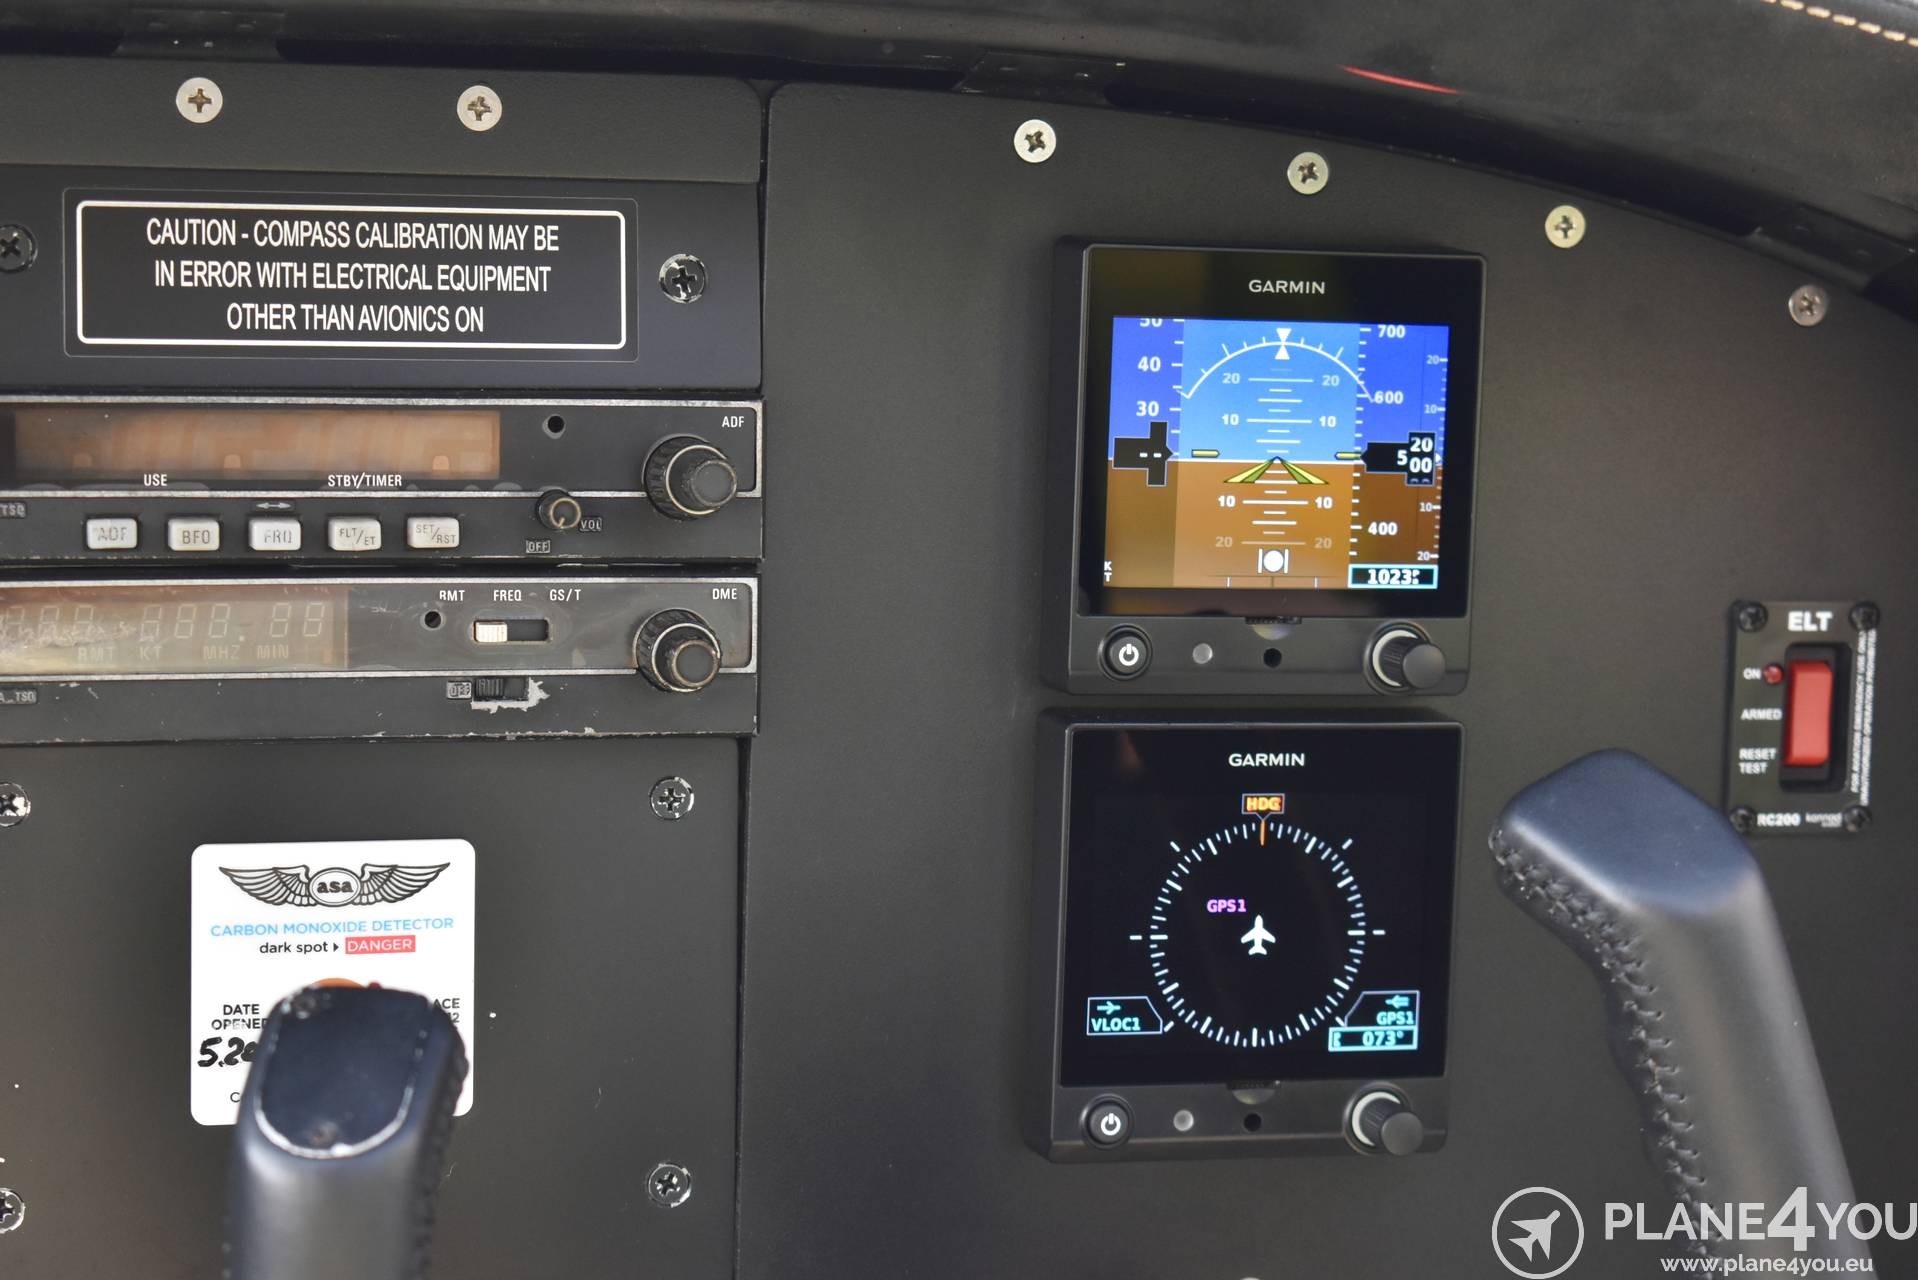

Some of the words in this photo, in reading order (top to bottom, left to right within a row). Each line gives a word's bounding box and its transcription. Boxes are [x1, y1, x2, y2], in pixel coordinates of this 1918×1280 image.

[146, 218, 236, 246] CAUTION
[254, 220, 350, 248] COMPASS
[356, 222, 482, 250] CALIBRATION
[489, 224, 529, 250] MAY
[534, 225, 559, 251] BE
[155, 260, 174, 287] IN
[180, 260, 252, 288] ERROR
[256, 261, 307, 288] WITH
[312, 262, 432, 290] ELECTRICAL
[437, 264, 551, 292] EQUIPMENT
[1248, 279, 1326, 295] GARMIN
[227, 302, 297, 330] OTHER
[301, 303, 354, 330] THAN
[358, 304, 449, 332] AVIONICS
[455, 306, 484, 332] ON
[1377, 324, 1406, 338] 700
[1138, 356, 1161, 372] 40
[1427, 354, 1440, 365] 20
[1222, 373, 1240, 385] 20
[1322, 375, 1340, 387] 20
[1374, 391, 1404, 405] 600
[1136, 401, 1160, 417] 30
[1424, 404, 1437, 414] 10
[722, 416, 745, 429] ADF
[1222, 414, 1239, 426] 10
[1319, 416, 1337, 428] 10
[1410, 437, 1433, 452] 20
[1409, 457, 1432, 473] 00
[143, 474, 168, 487] USE
[328, 473, 402, 488] STBY/TIMER
[1218, 496, 1236, 508] 10
[1315, 497, 1333, 509] 10
[1419, 502, 1433, 512] 10
[581, 519, 601, 530] VOL
[1368, 522, 1398, 536] 400
[182, 530, 210, 545] BFO
[1215, 536, 1233, 548] 20
[1315, 537, 1332, 549] 20
[528, 541, 548, 552] OFF
[1417, 551, 1431, 561] 20
[1368, 569, 1412, 585] 1023
[439, 590, 465, 602] RMT
[494, 589, 522, 602] FREQ
[550, 589, 582, 602] GS/T
[712, 588, 737, 600] DME
[1787, 611, 1833, 632] ELT
[1743, 667, 1762, 680] ON
[1741, 708, 1782, 721] ARMED
[1228, 753, 1305, 768] GARMIN
[1739, 748, 1777, 761] RESET
[1739, 762, 1767, 775] TEST
[1246, 797, 1281, 812] HDG
[1757, 812, 1800, 827] RC200
[317, 880, 353, 894] asa
[1207, 899, 1247, 913] GPS1
[210, 923, 278, 938] CARBON
[283, 920, 367, 936] MONOXIDE
[372, 917, 454, 932] DETECTOR
[259, 941, 292, 954] dark
[296, 940, 329, 957] spot
[347, 938, 413, 953] DANGER
[432, 997, 461, 1009] ACE
[223, 1004, 260, 1016] DATE
[1092, 1017, 1141, 1032] VLOC1
[1376, 1011, 1414, 1026] GPS1
